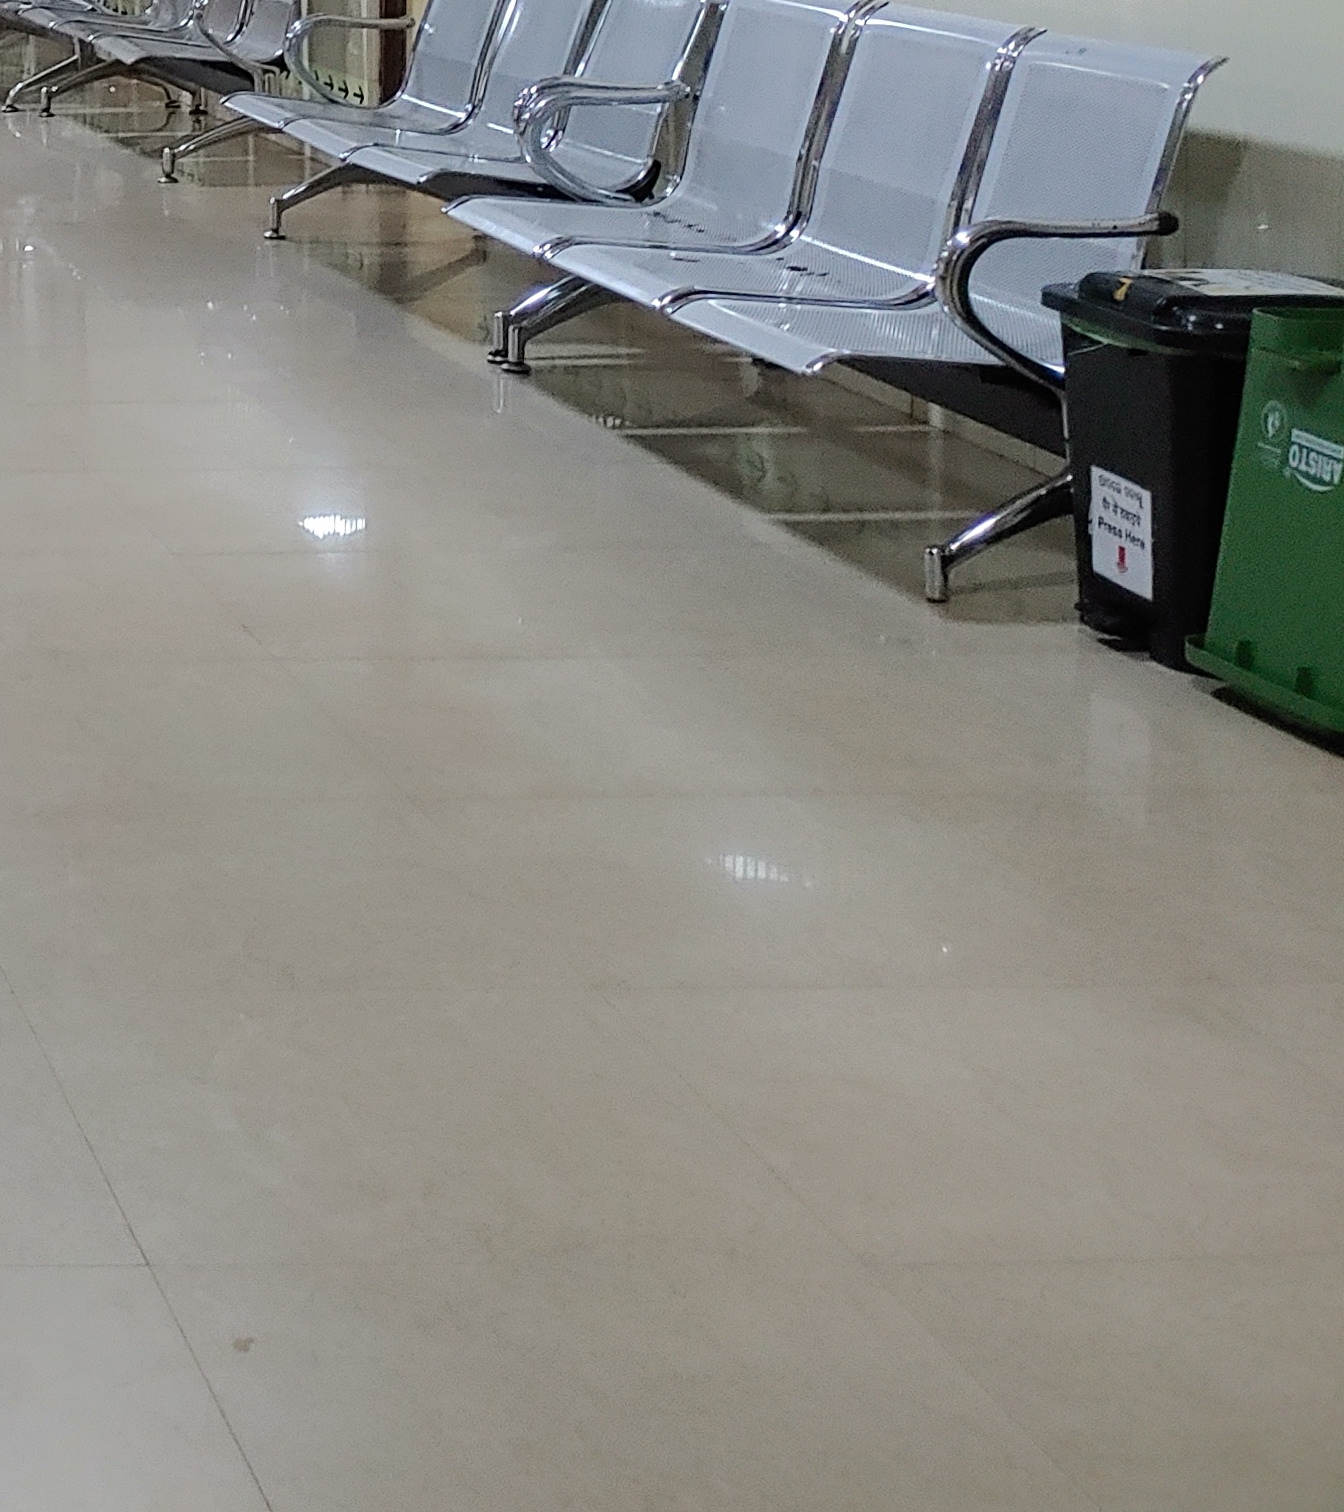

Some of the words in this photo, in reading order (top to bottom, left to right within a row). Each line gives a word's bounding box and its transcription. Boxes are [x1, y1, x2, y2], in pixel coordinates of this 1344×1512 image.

[1288, 443, 1344, 485] ARISTO
[1098, 515, 1123, 540] Press
[1124, 528, 1146, 551] Here
